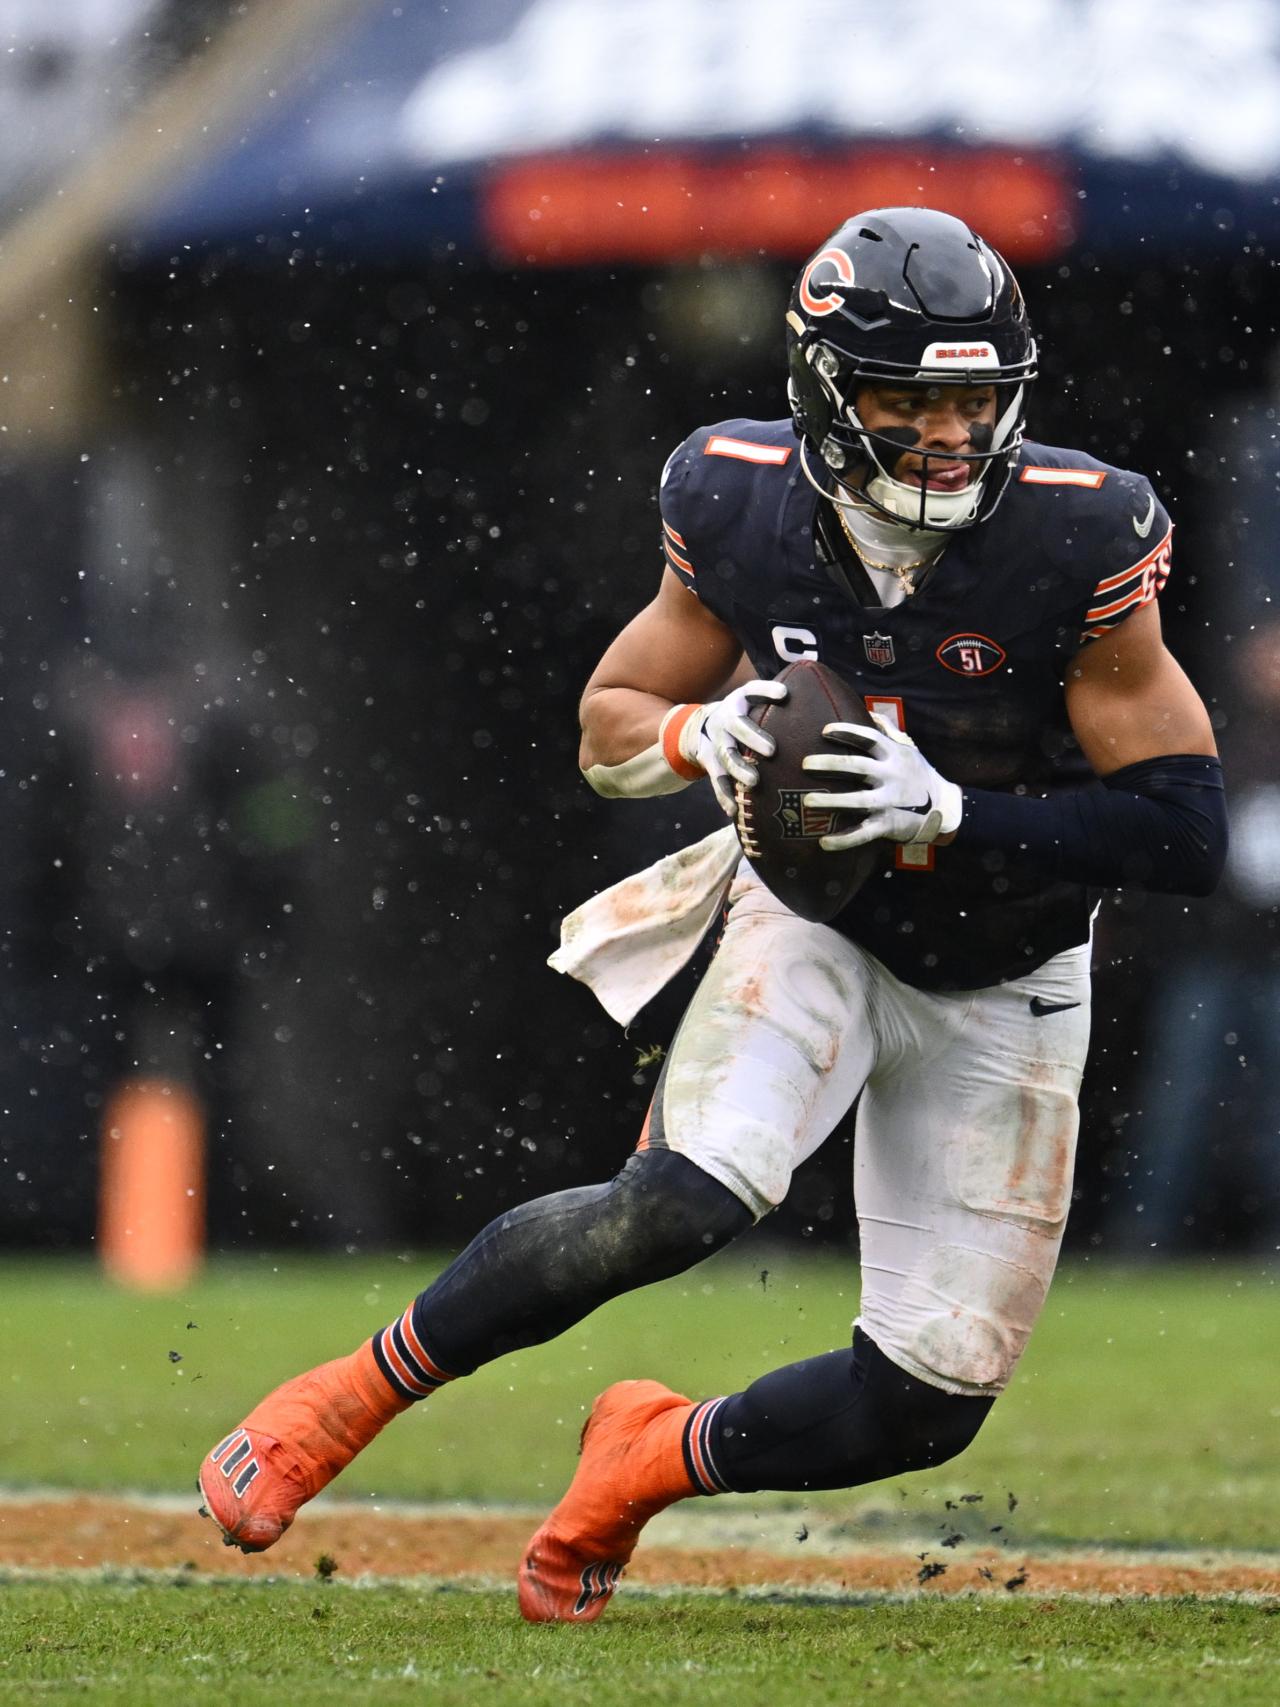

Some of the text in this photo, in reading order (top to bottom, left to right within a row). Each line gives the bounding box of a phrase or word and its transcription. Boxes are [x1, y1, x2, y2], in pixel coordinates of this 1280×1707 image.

[935, 347, 989, 359] BEARS
[704, 435, 793, 466] 1
[1019, 465, 1108, 490] 1
[771, 626, 819, 663] C
[959, 649, 983, 671] 51
